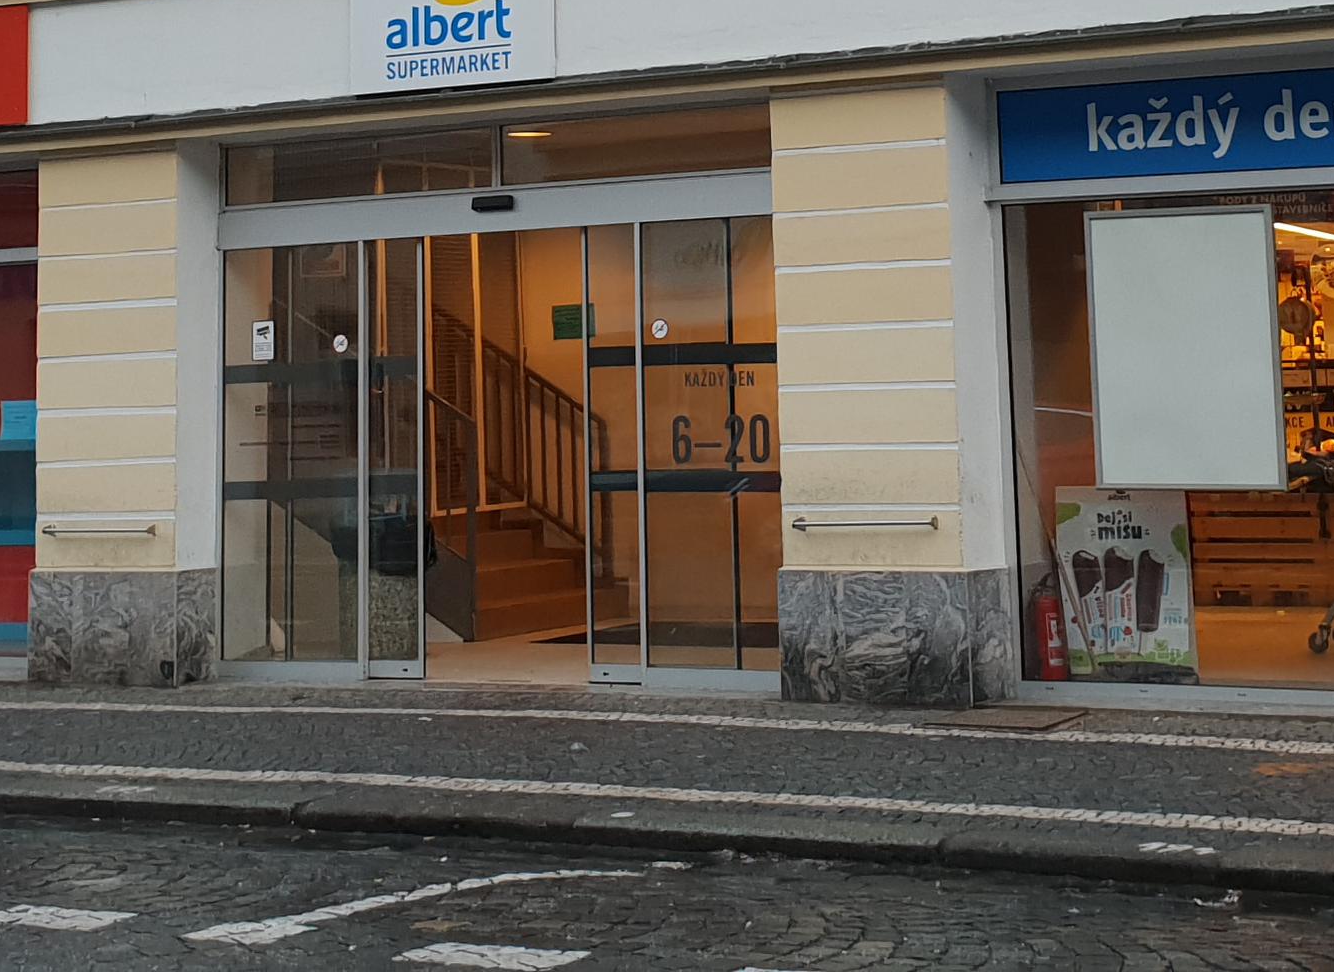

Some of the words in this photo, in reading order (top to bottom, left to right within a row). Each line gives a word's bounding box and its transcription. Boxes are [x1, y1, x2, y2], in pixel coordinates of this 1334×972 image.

[386, 51, 512, 80] SUPERMARKET
[1085, 92, 1240, 160] každý
[729, 370, 755, 387] DEN
